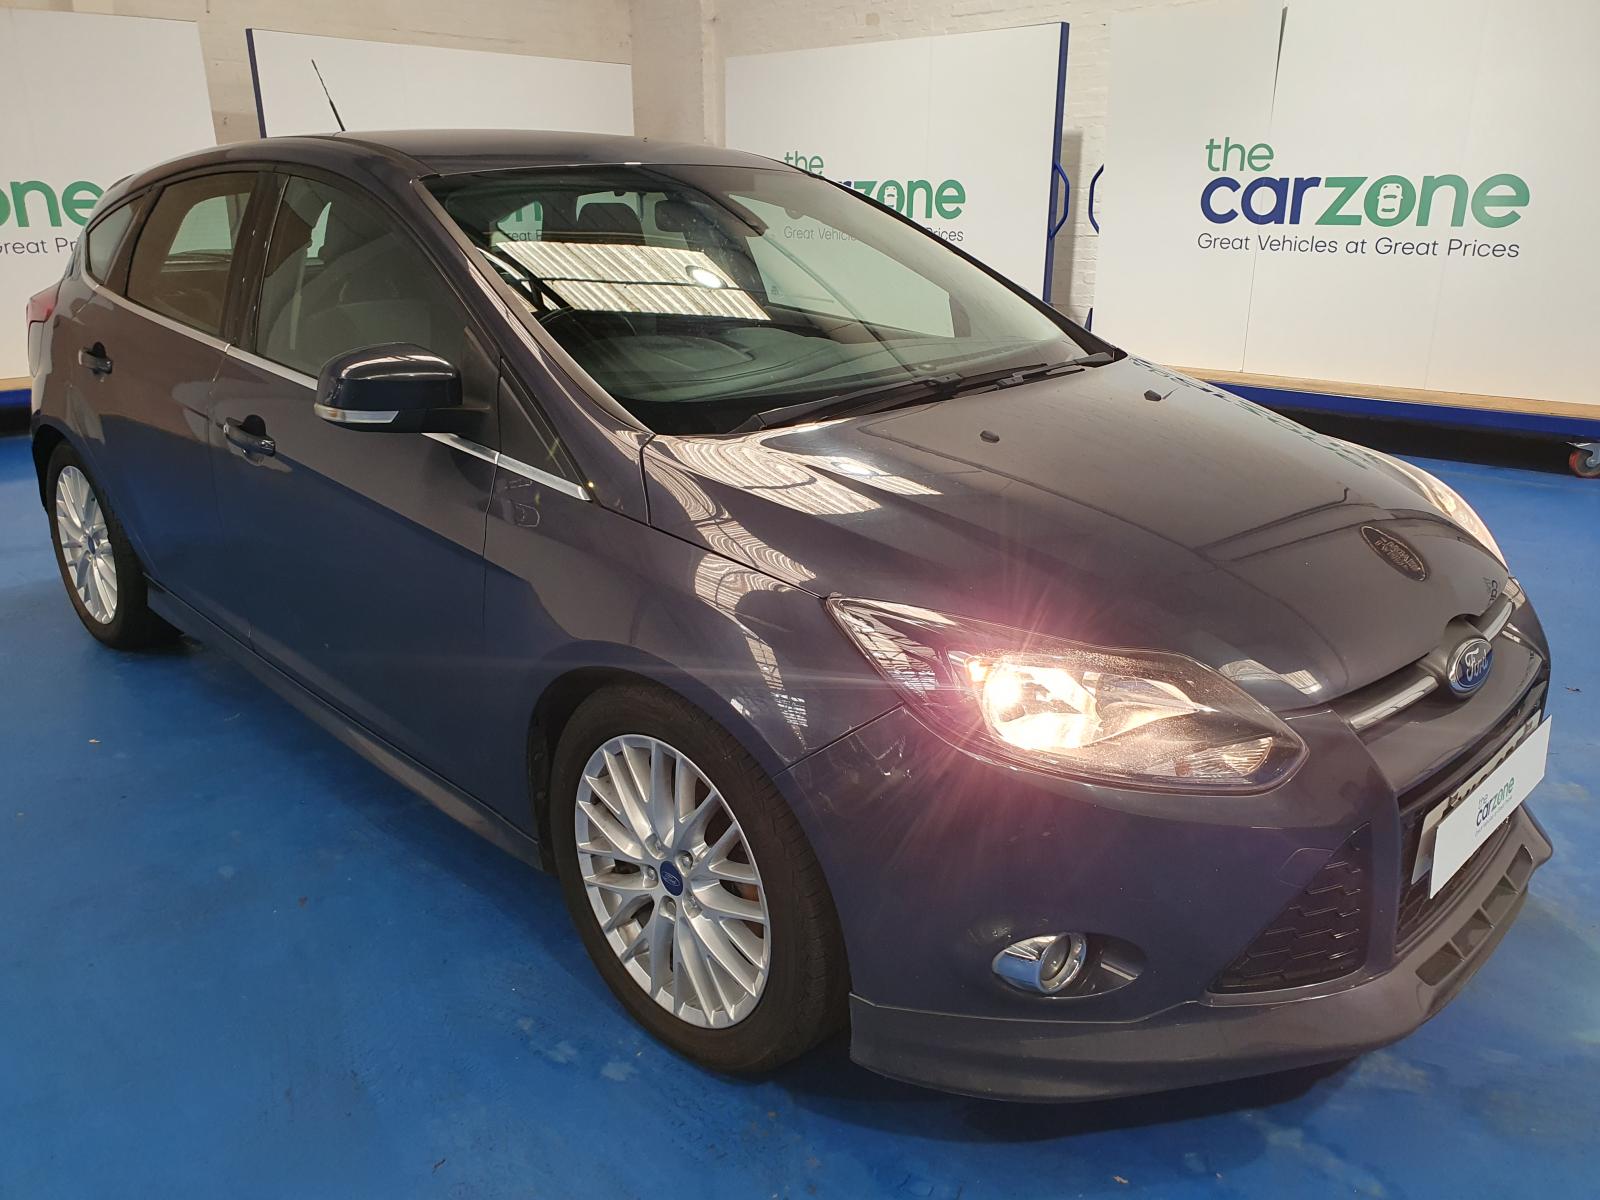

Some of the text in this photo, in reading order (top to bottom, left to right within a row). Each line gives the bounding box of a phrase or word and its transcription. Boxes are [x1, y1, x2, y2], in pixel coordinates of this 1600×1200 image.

[1205, 137, 1274, 172] the
[0, 180, 104, 227] ne
[1200, 173, 1530, 228] carzone
[0, 239, 48, 254] reat
[784, 226, 815, 240] Great
[1197, 232, 1520, 258] Great Vehicles at Great Prices
[1465, 647, 1489, 682] Ford
[1476, 777, 1515, 827] carzone
